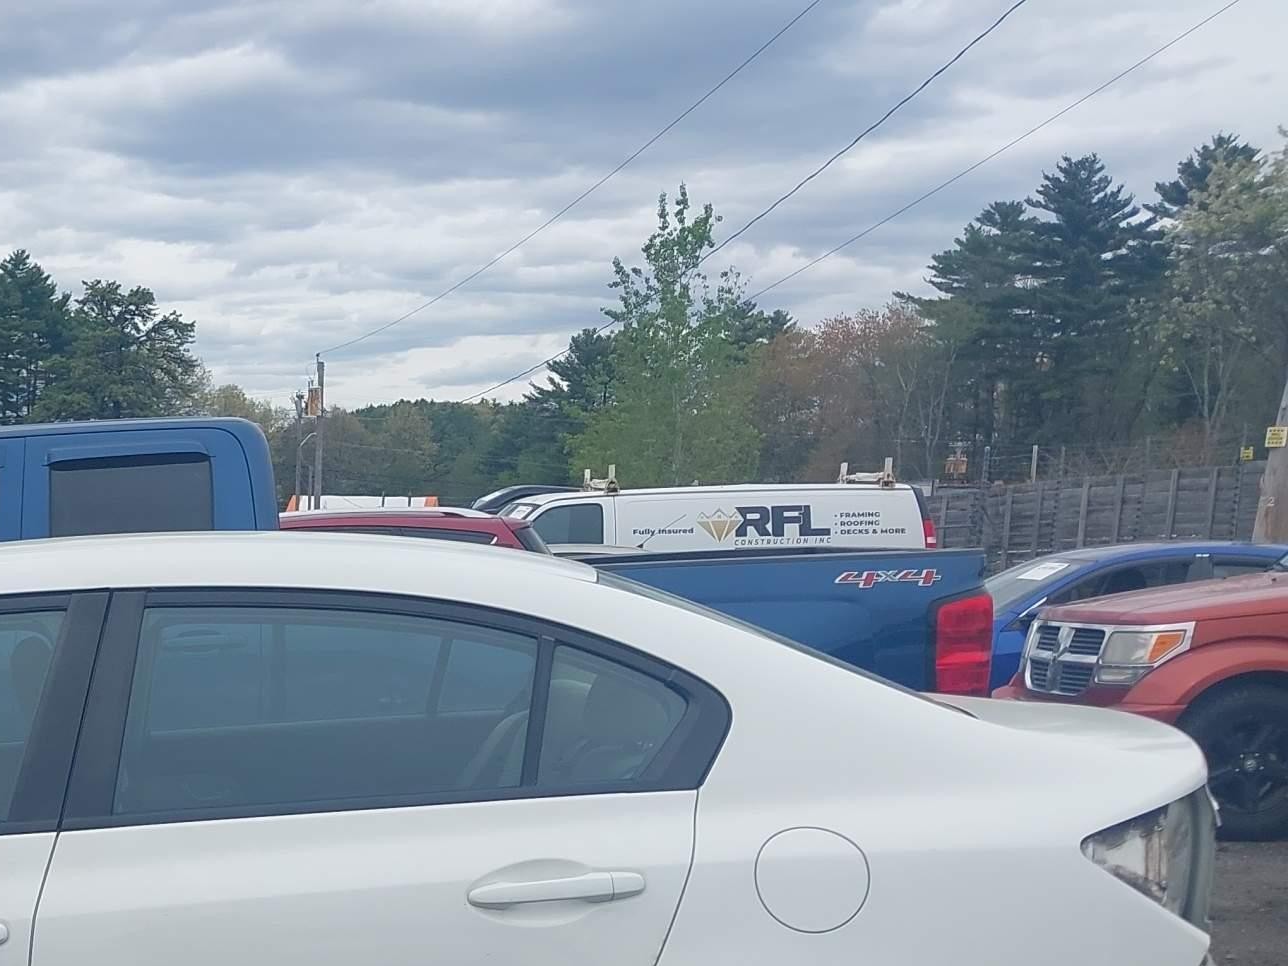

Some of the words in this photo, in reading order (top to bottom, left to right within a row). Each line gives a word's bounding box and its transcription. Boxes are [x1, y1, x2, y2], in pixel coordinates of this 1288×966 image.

[735, 505, 831, 537] RFL
[632, 528, 656, 537] Fully
[658, 527, 694, 535] Insured
[734, 537, 809, 546] CONSTRUCTION
